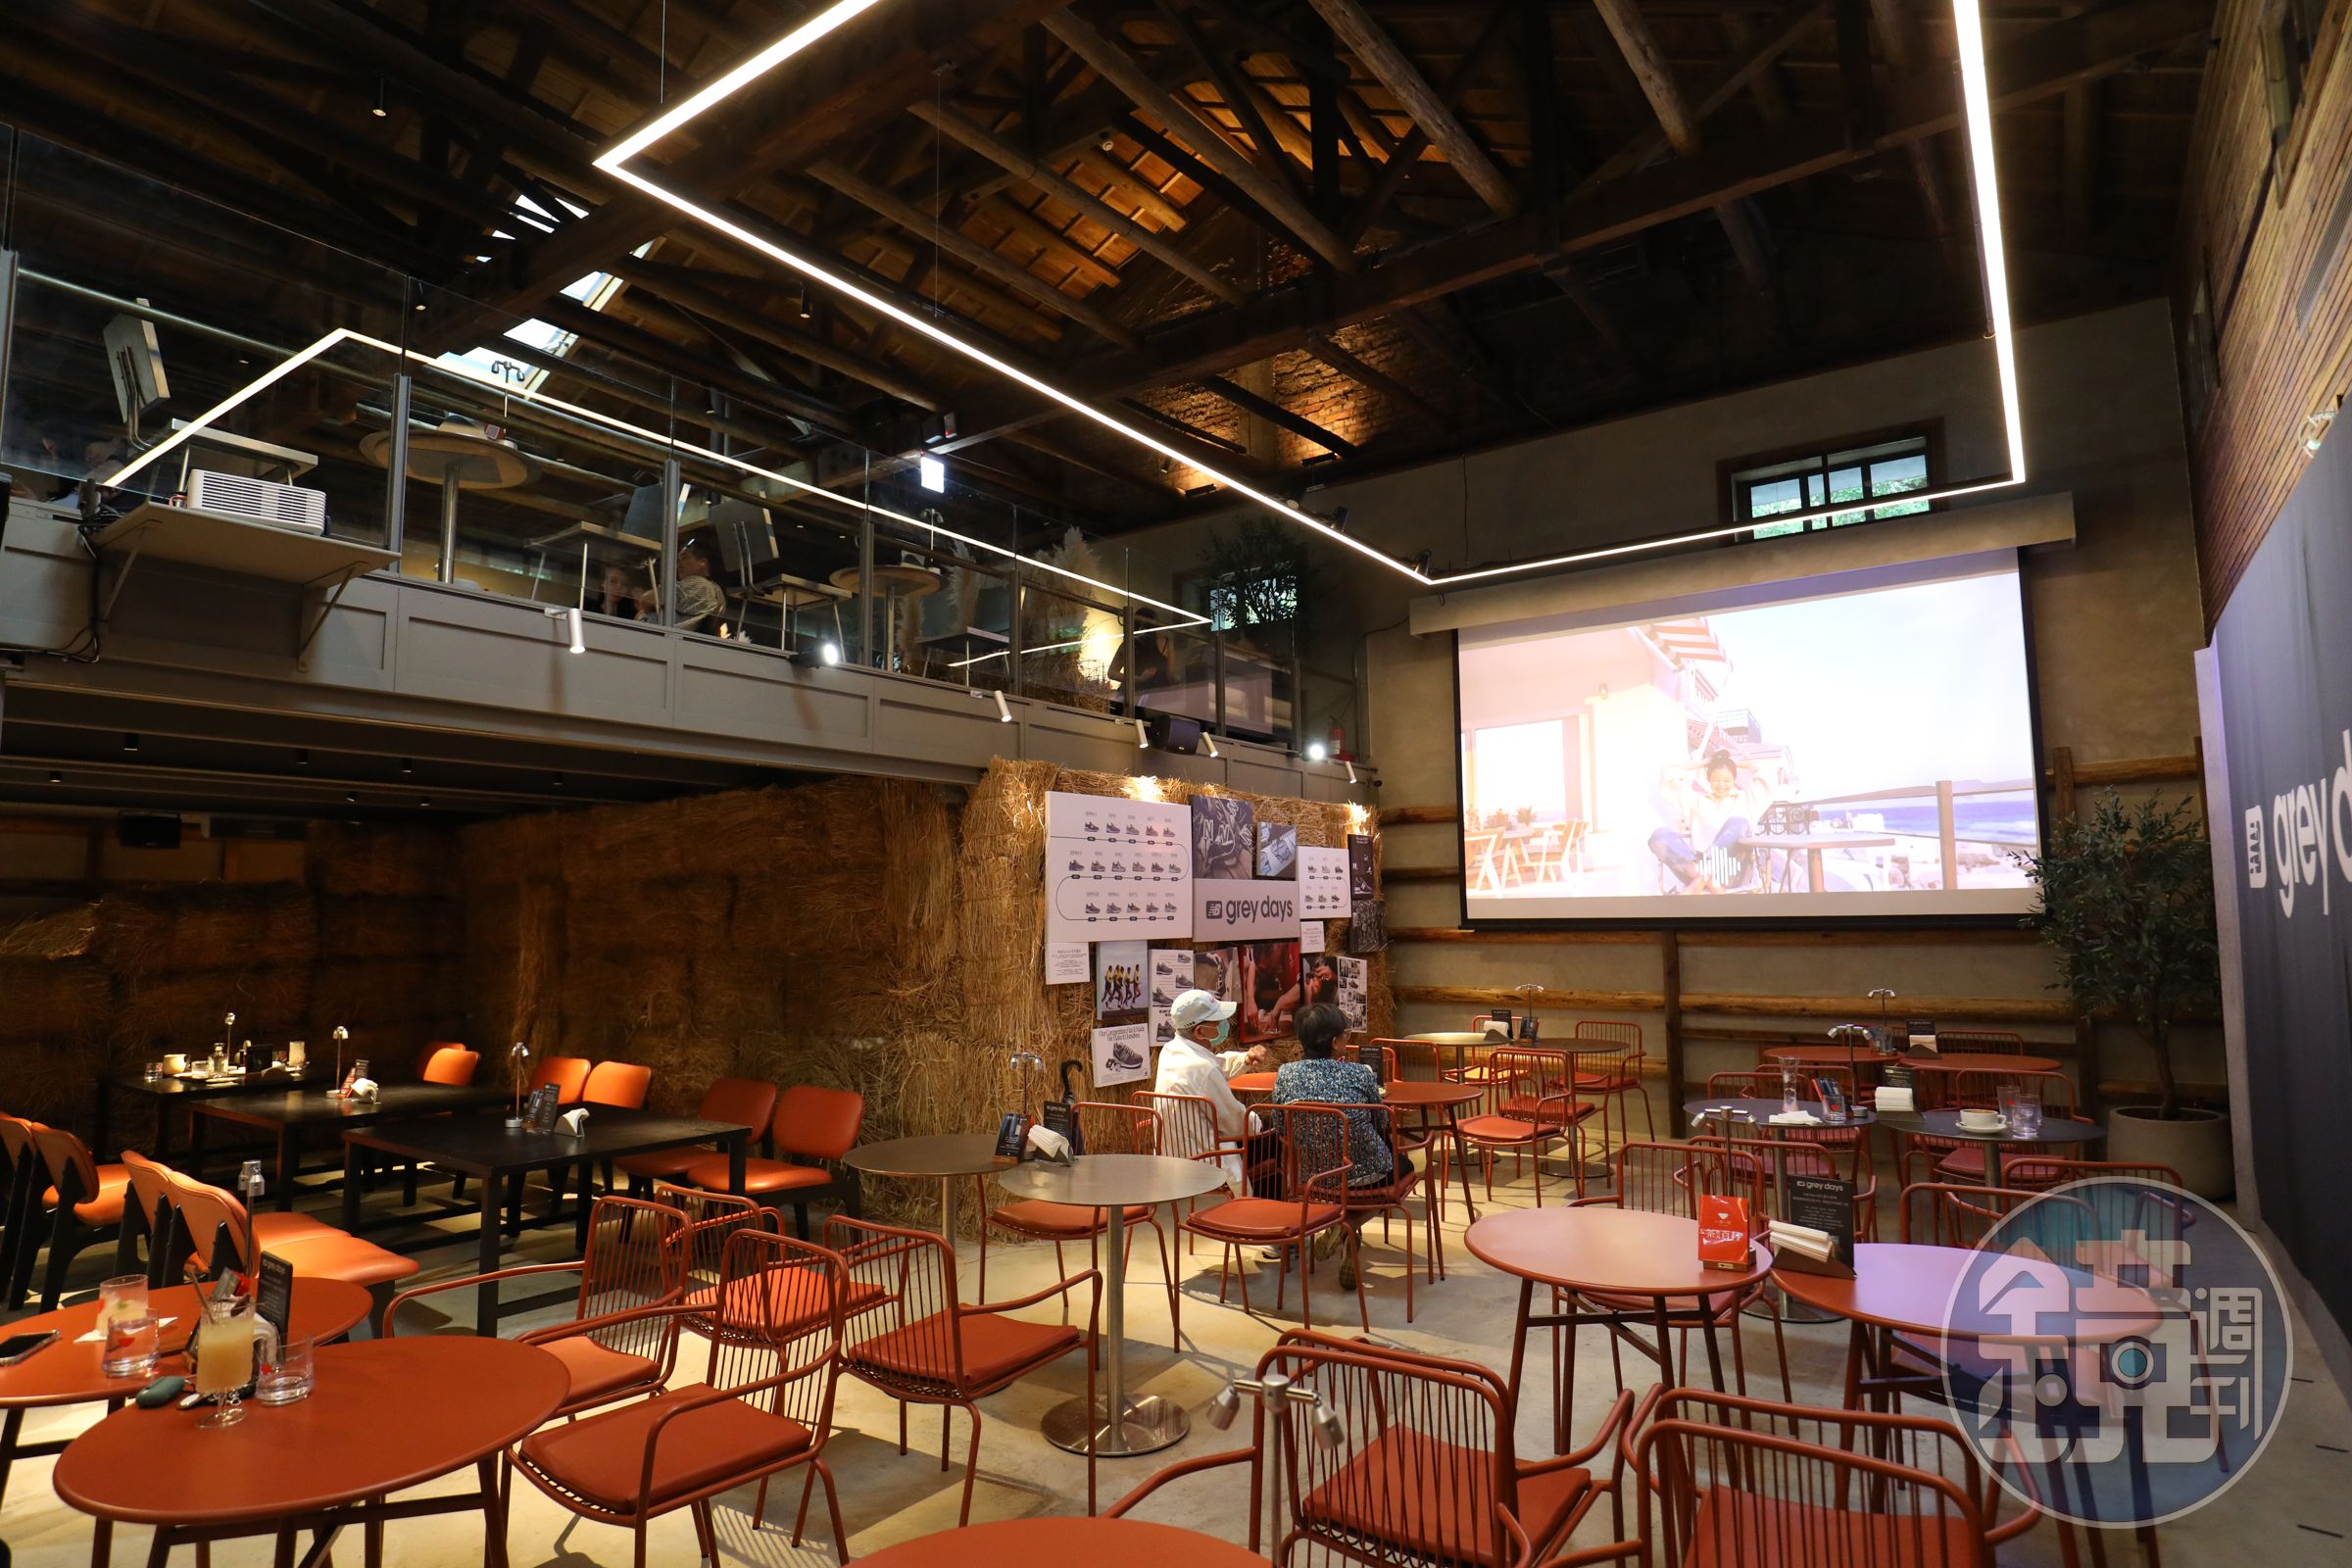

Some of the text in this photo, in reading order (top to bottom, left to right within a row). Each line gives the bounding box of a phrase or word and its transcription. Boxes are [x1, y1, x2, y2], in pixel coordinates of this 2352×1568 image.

[2273, 777, 2328, 919] grey
[1226, 900, 1258, 924] grey
[1260, 896, 1293, 922] days
[1824, 1183, 1843, 1192] days
